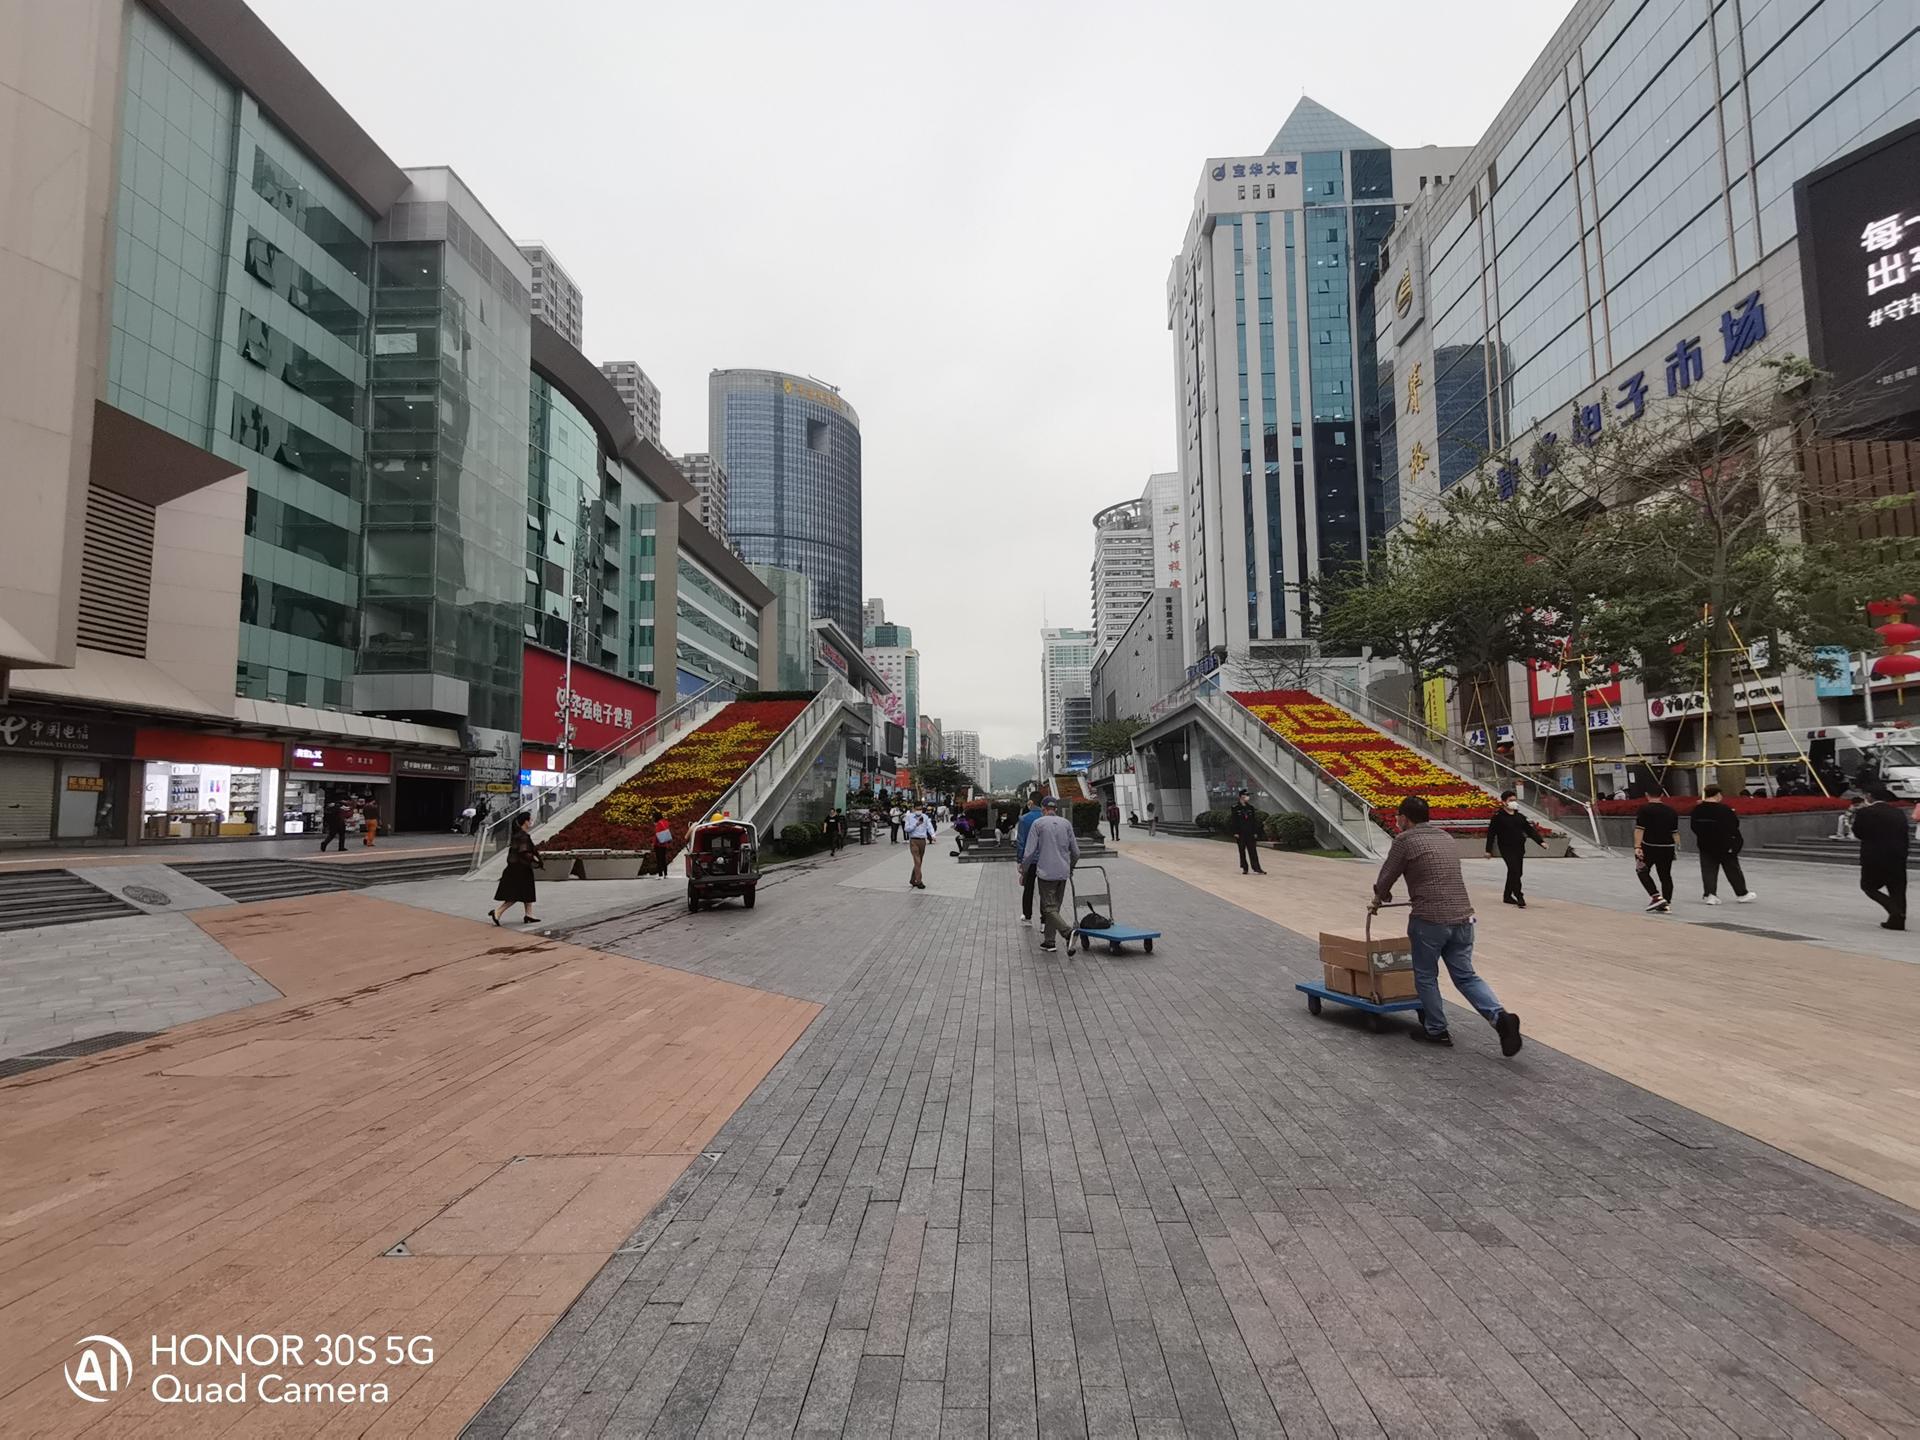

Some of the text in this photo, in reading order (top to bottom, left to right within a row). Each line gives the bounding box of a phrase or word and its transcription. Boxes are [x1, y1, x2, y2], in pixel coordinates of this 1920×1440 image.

[1232, 161, 1298, 178] 宝华大厦
[570, 692, 634, 730] 华强电子世界
[30, 720, 89, 740] 中国电信
